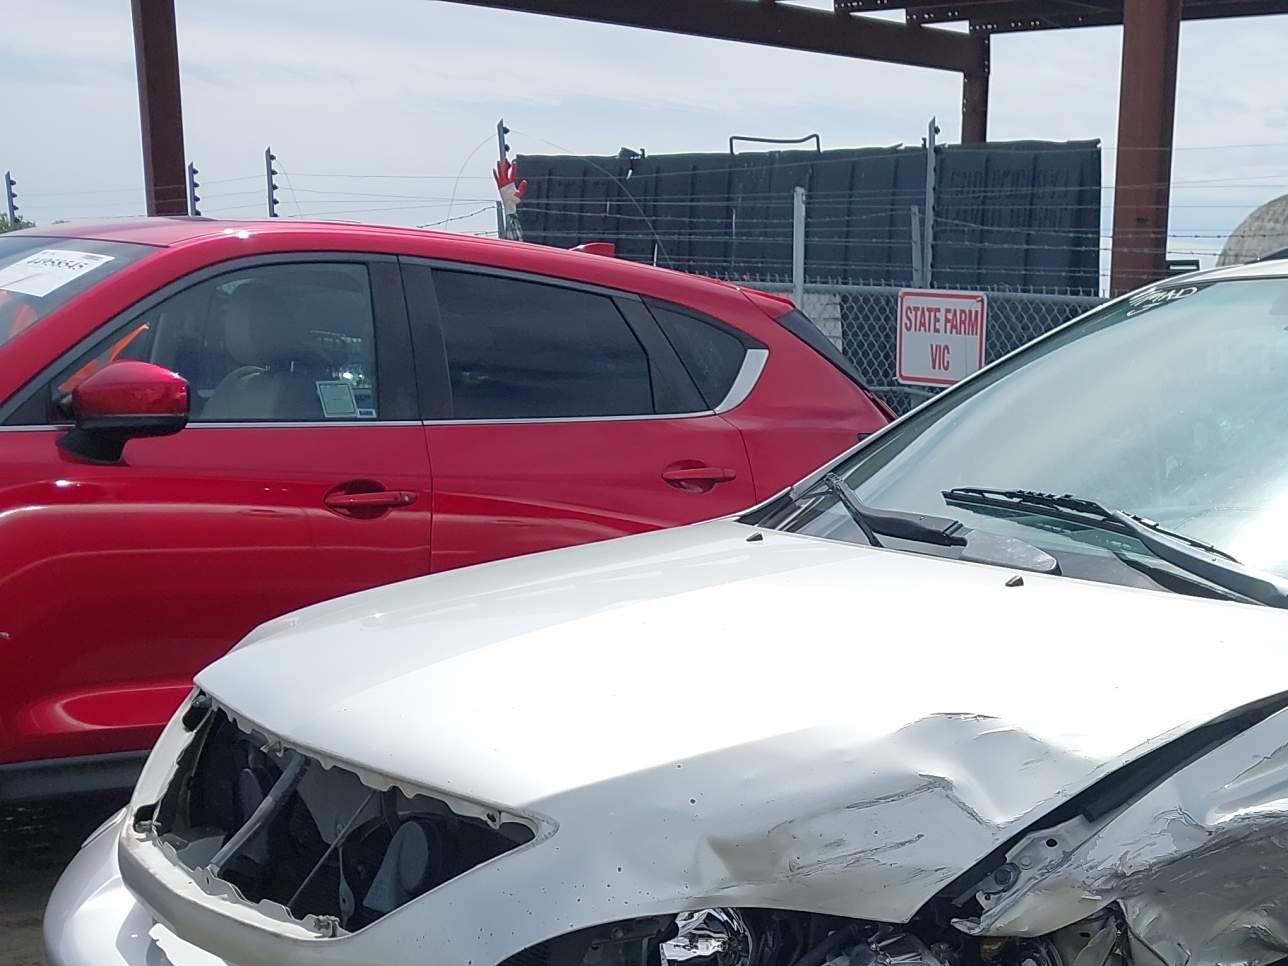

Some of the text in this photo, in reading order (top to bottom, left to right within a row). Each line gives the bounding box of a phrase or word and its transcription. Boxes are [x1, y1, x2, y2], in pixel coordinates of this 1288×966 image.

[904, 305, 979, 336] STATE FARM
[930, 343, 950, 371] VIC
